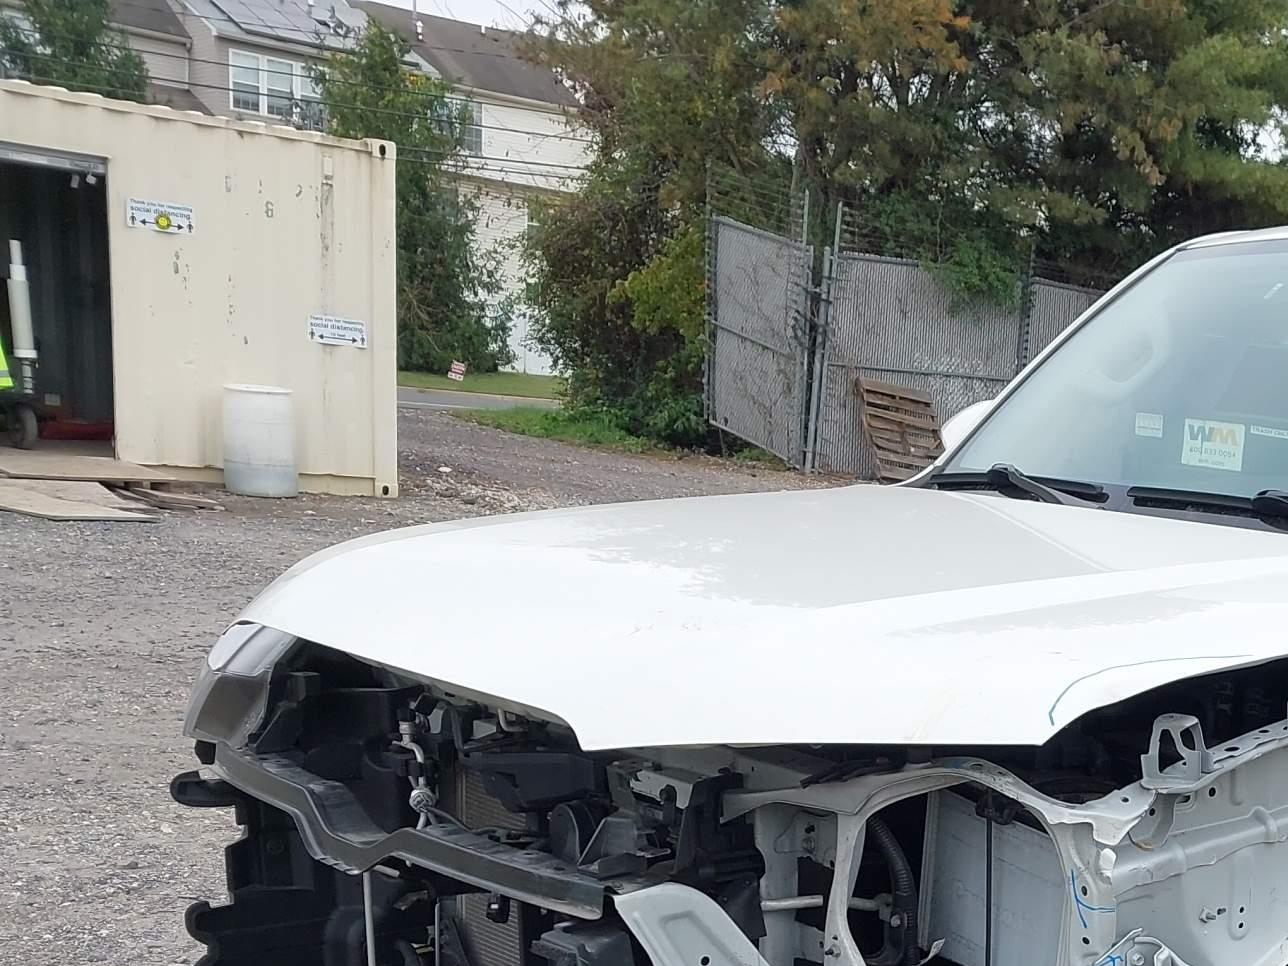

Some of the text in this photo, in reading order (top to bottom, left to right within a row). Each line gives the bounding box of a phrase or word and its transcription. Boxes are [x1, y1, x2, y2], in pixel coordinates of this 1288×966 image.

[130, 205, 152, 214] social
[310, 321, 329, 329] social
[1188, 423, 1238, 446] WM
